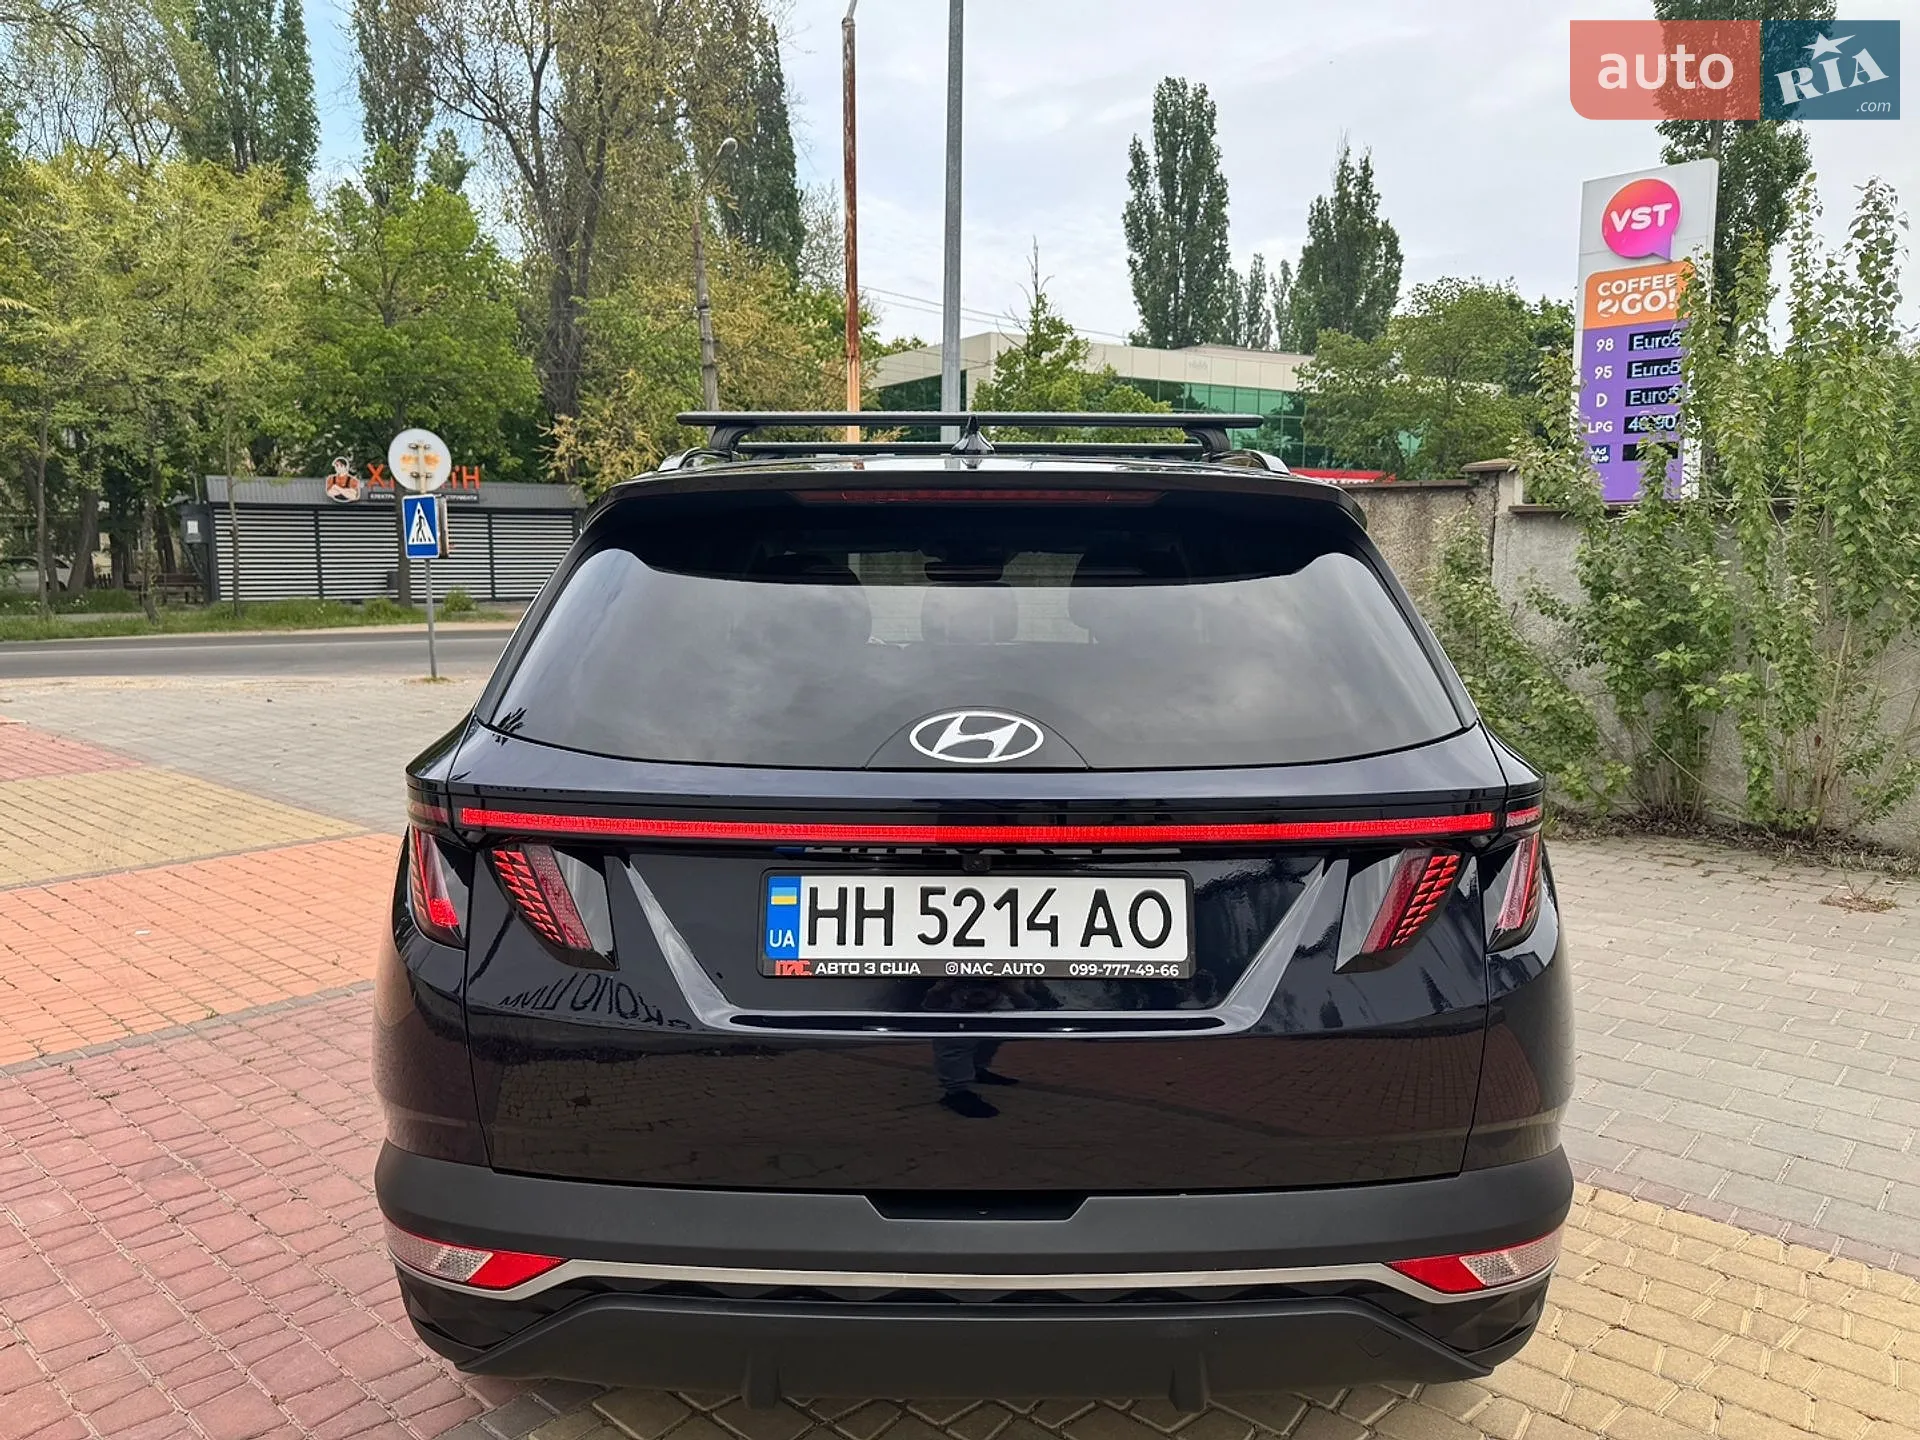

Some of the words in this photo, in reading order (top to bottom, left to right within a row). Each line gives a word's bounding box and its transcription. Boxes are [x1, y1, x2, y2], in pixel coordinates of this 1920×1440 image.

[1610, 202, 1673, 232] VST
[1597, 273, 1677, 296] COFFEE
[1596, 337, 1614, 352] 98
[1594, 365, 1613, 379] 95
[1596, 392, 1608, 408] D
[1588, 421, 1613, 433] LPG
[807, 886, 895, 947] HH
[917, 886, 1059, 947] 5214
[1080, 888, 1172, 949] AO
[769, 931, 795, 948] UA
[880, 962, 921, 975] США
[1069, 963, 1179, 977] 099-777-49-66
